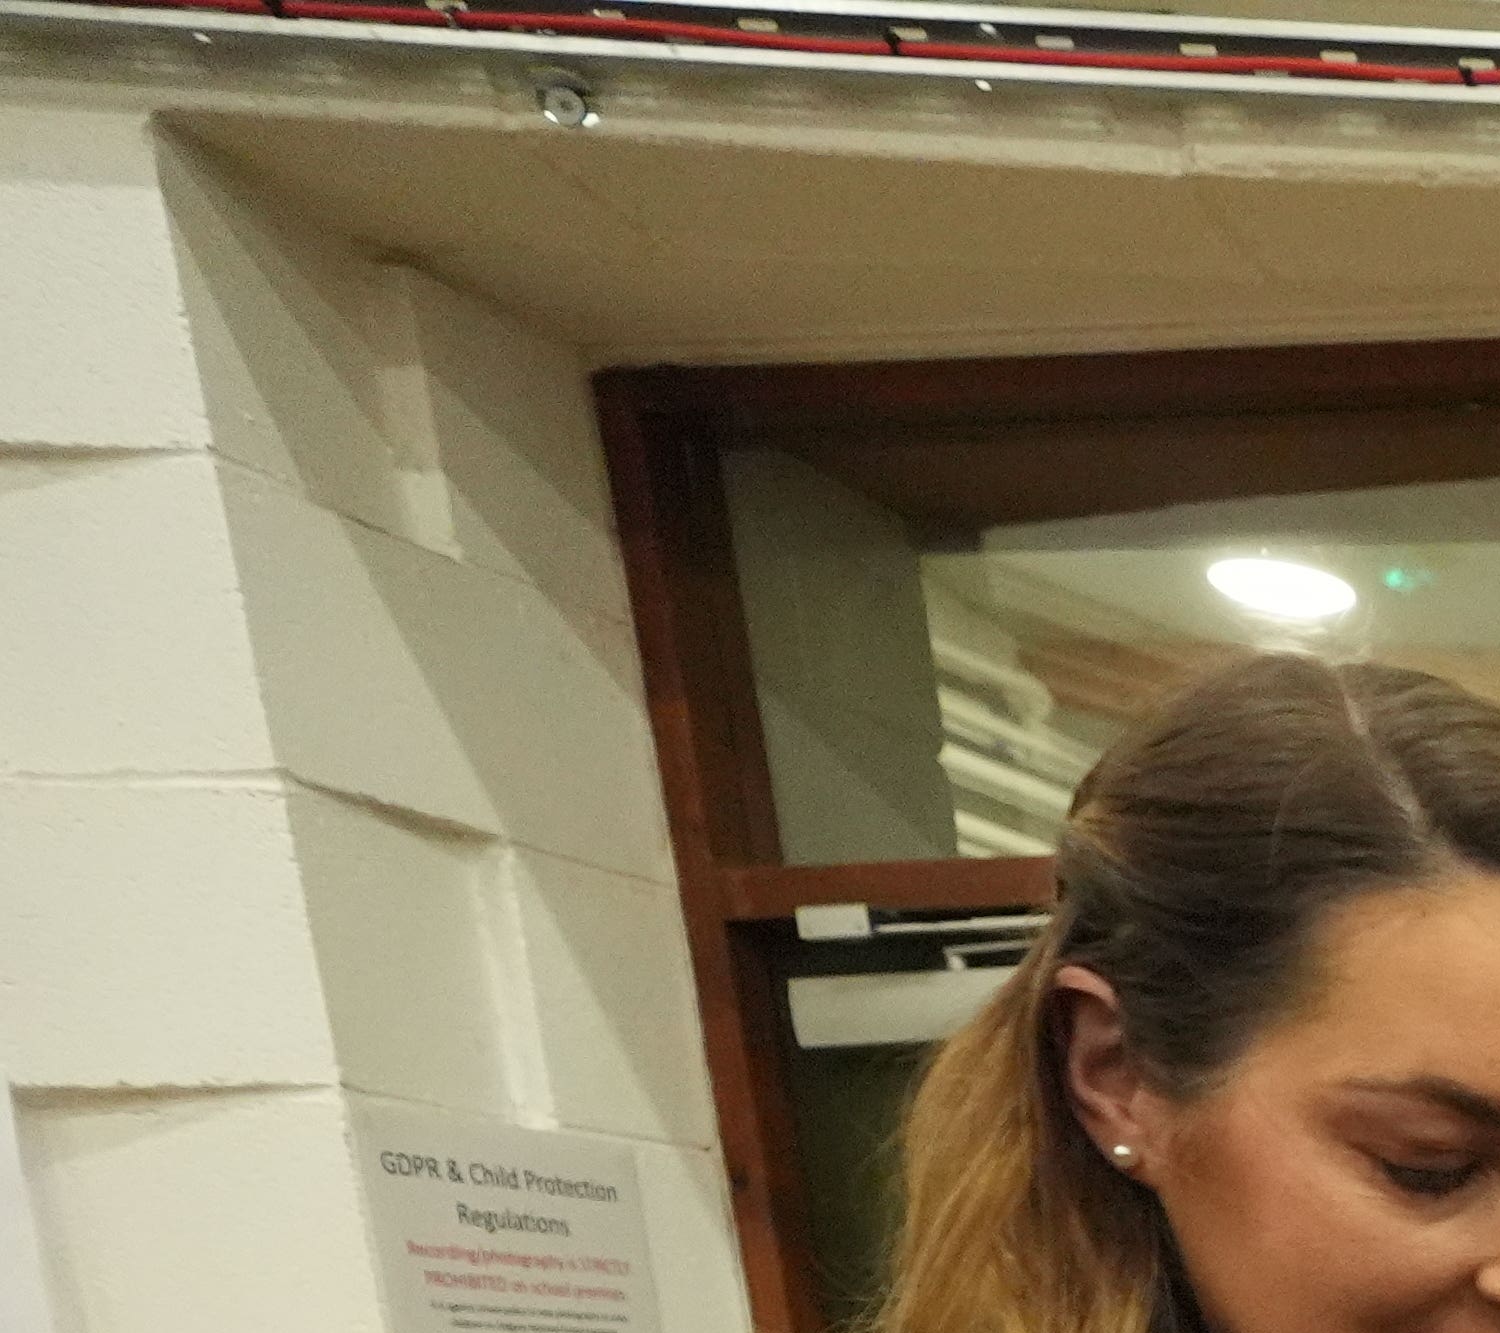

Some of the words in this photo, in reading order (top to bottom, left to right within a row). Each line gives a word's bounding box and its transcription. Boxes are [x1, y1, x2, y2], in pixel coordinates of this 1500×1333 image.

[380, 1150, 440, 1179] GDPR
[447, 1158, 465, 1184] &
[469, 1163, 518, 1190] Child
[522, 1169, 618, 1202] Protection
[456, 1202, 571, 1237] Regulations
